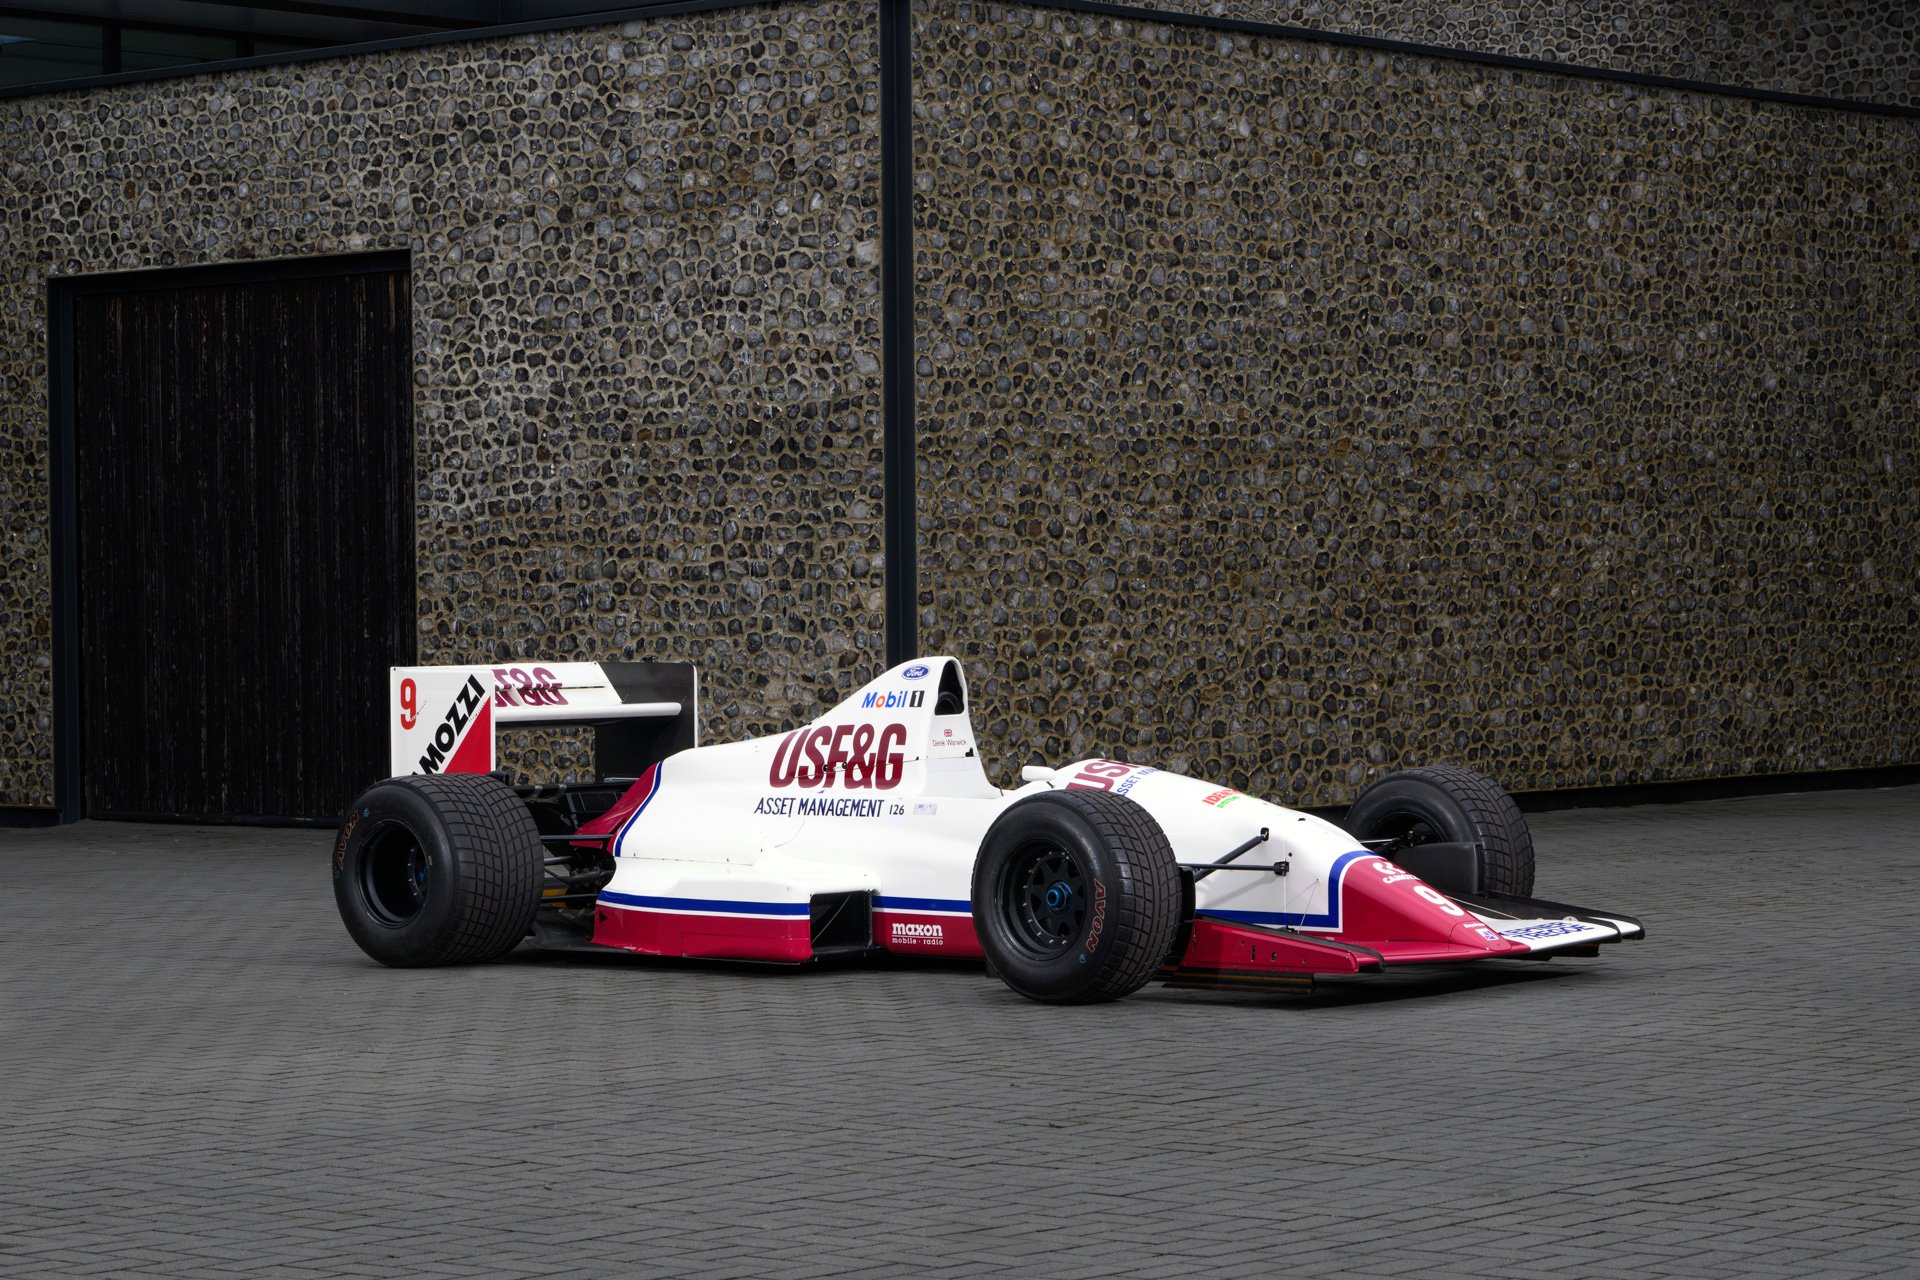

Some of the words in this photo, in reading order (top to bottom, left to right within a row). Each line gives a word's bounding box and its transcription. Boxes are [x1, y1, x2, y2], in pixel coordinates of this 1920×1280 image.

[905, 667, 926, 678] Ford
[400, 678, 417, 730] 9
[861, 690, 908, 708] Mobil
[912, 691, 924, 707] 1
[412, 674, 486, 775] MOZZI
[769, 723, 907, 790] USF&G
[932, 739, 945, 747] Derek
[754, 798, 796, 816] ASSET
[798, 798, 884, 817] MANAGEMENT
[889, 805, 905, 815] 126
[337, 809, 360, 870] AVON
[1086, 878, 1106, 953] AVON
[1414, 886, 1464, 916] 9
[892, 923, 943, 936] maxon
